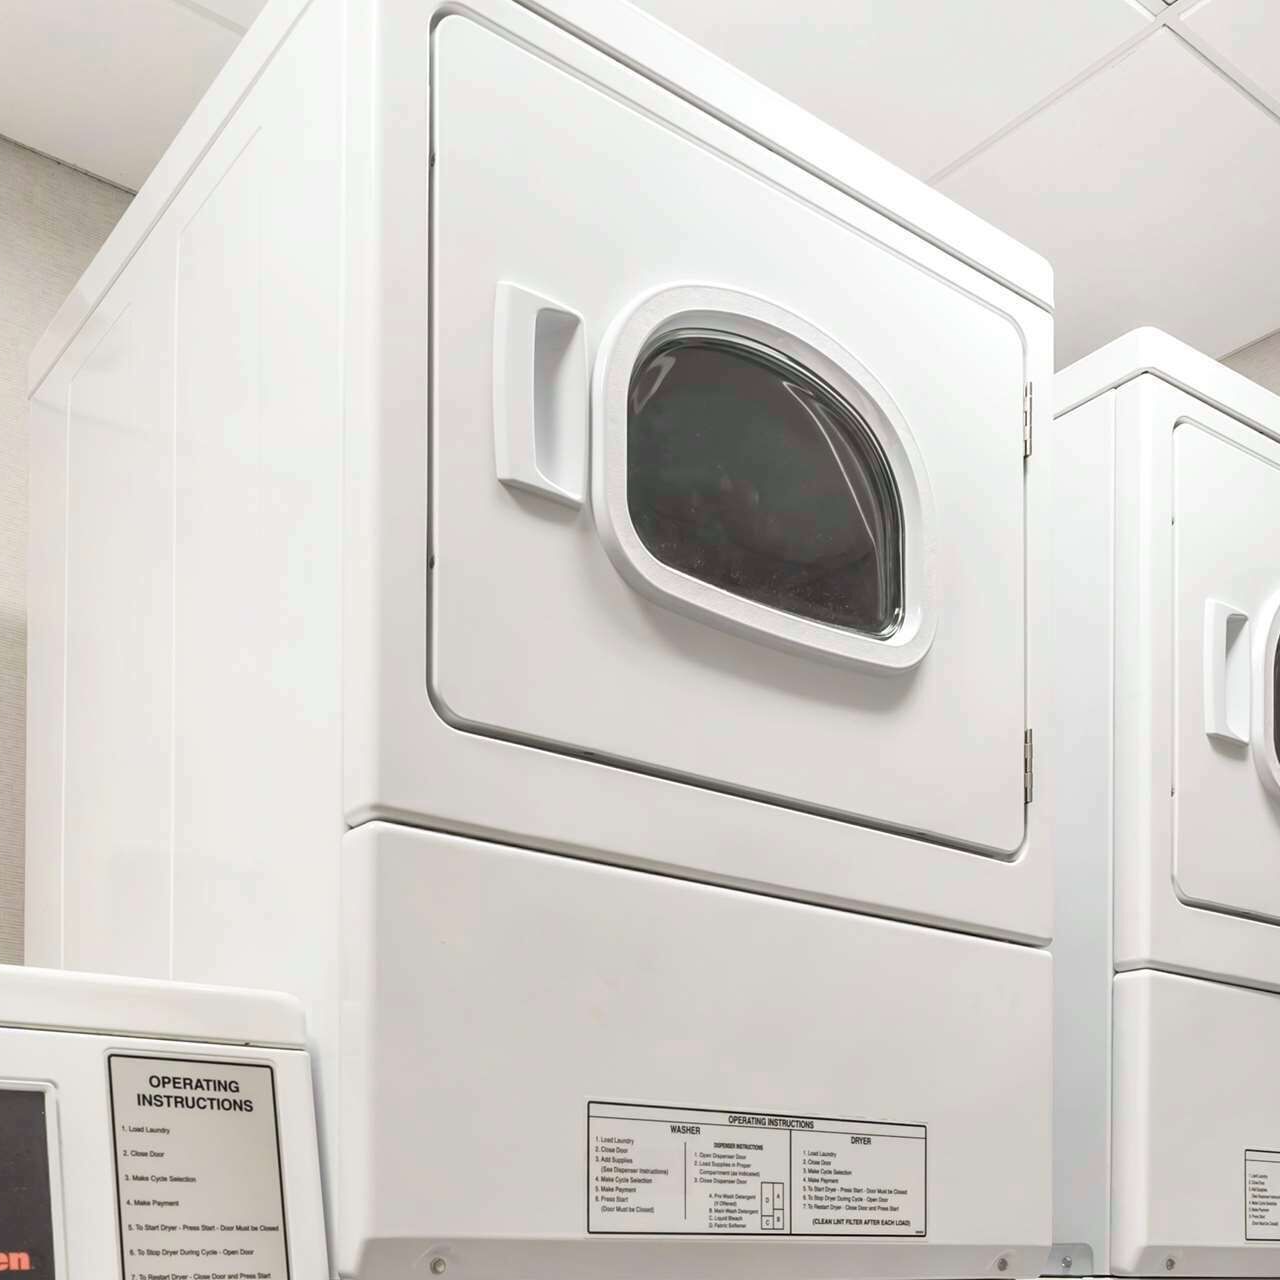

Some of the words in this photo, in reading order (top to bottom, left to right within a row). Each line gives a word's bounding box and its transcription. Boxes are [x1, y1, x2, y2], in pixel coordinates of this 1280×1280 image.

[148, 1075, 240, 1093] OPERATING
[136, 1093, 254, 1112] INSTRUCTIONS
[728, 1115, 767, 1126] OPERATING
[768, 1117, 815, 1129] INSTRUCTIONS
[145, 1126, 170, 1135] Laundry
[670, 1125, 701, 1135] WASHER
[850, 1136, 872, 1145] DRYER
[149, 1150, 165, 1158] Door
